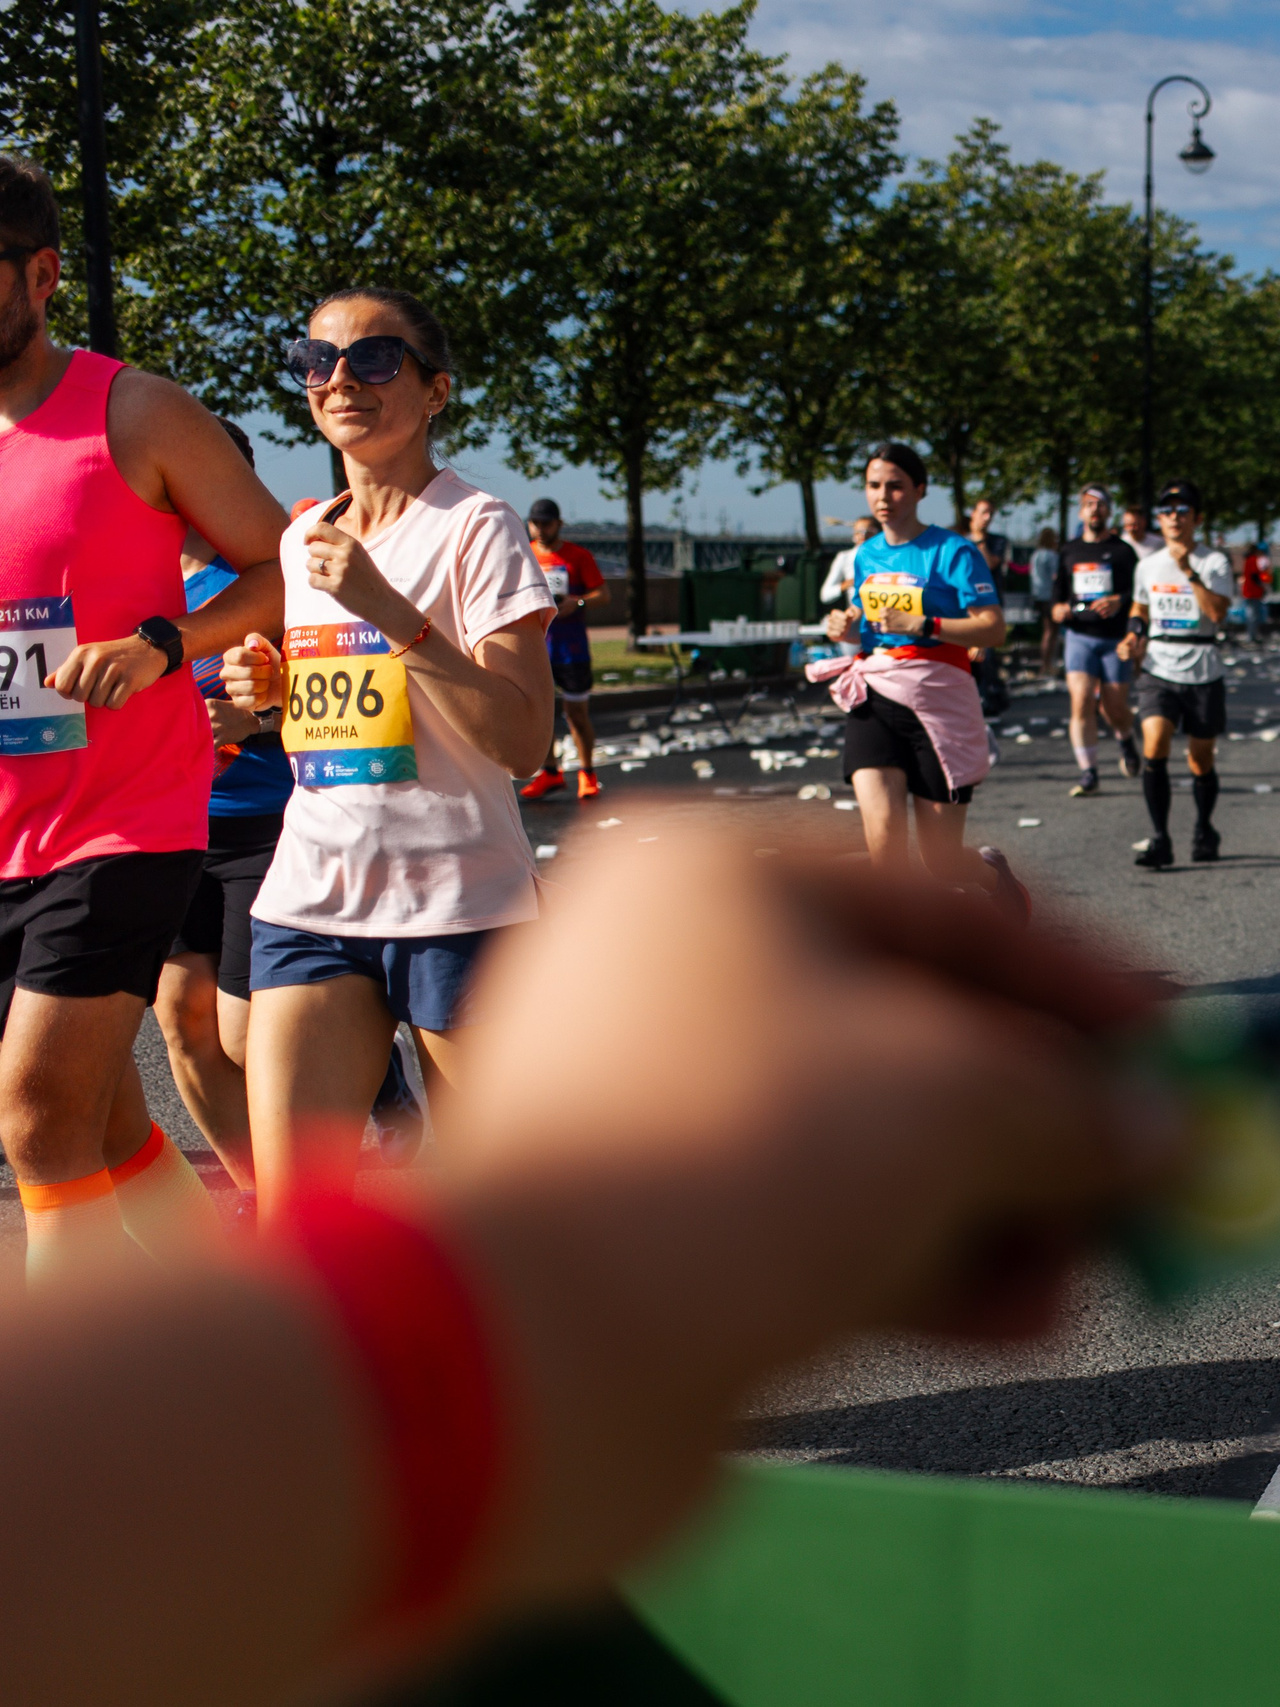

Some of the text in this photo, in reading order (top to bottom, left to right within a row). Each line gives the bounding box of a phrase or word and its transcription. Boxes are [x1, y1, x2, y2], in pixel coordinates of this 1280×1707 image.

[868, 591, 912, 612] 5923
[1157, 597, 1192, 611] 6160
[336, 632, 356, 647] 21,1
[289, 669, 384, 722] 6896
[305, 725, 358, 740] МАРИНА
